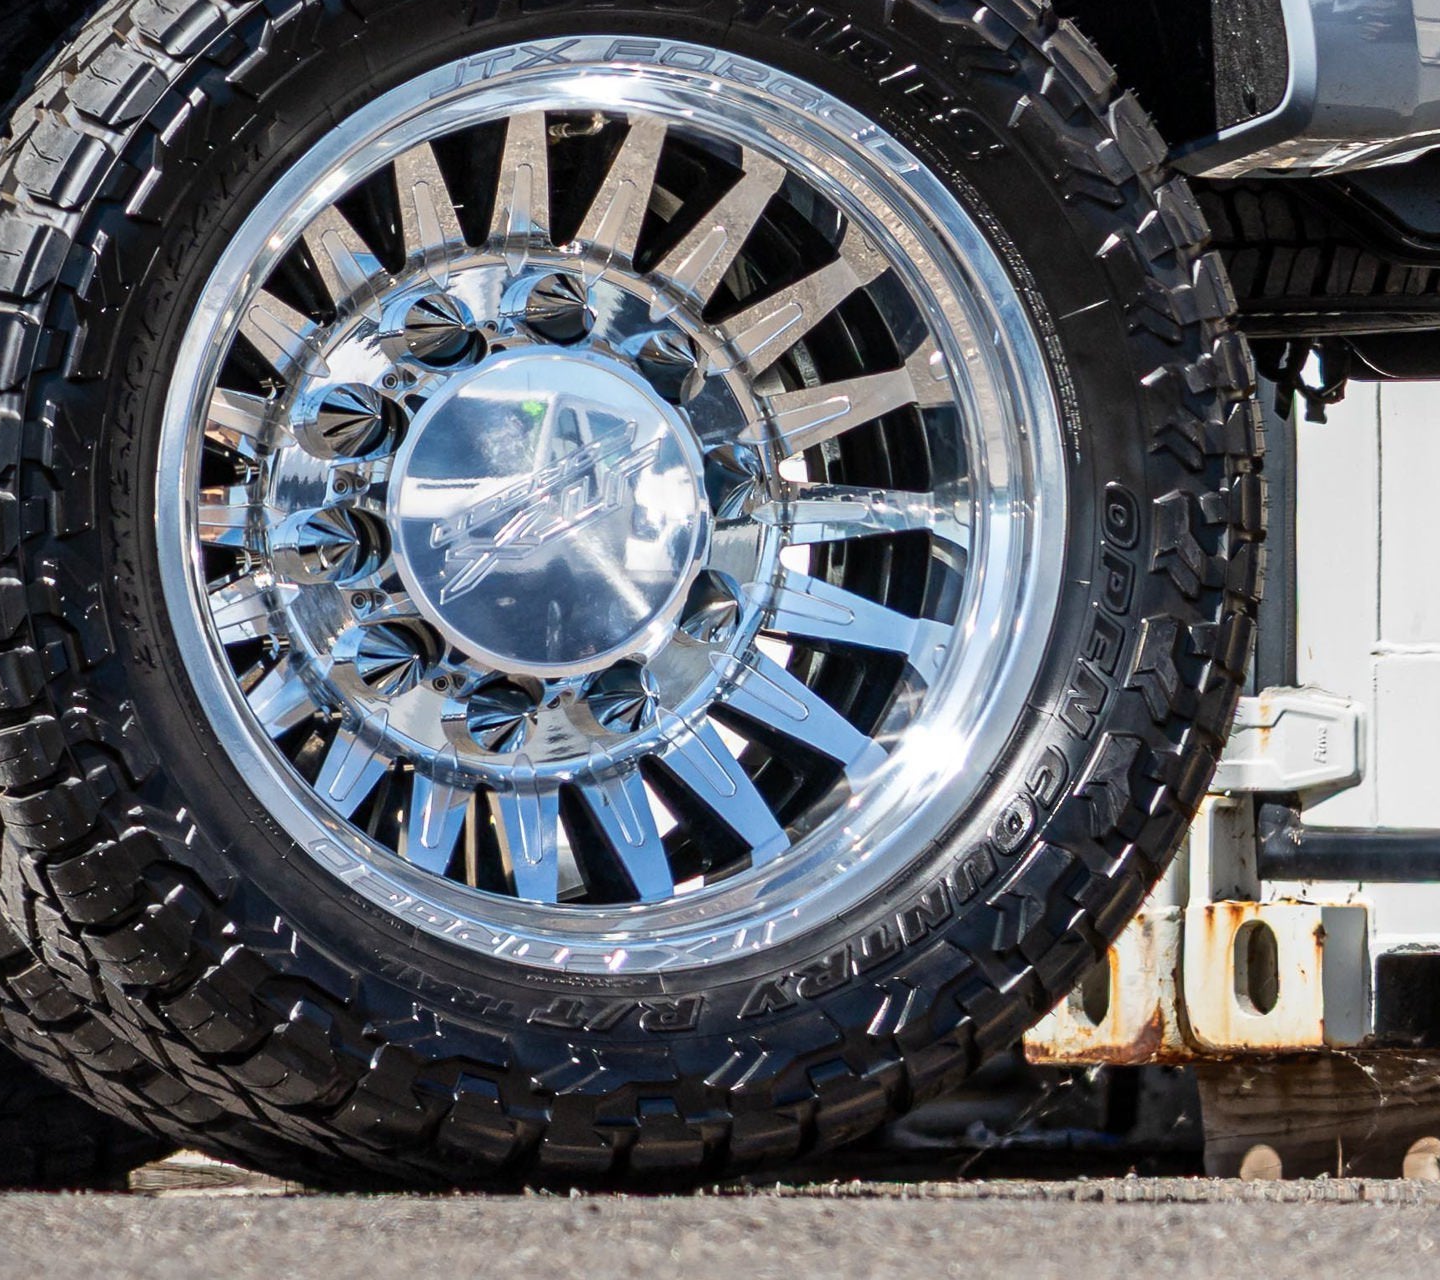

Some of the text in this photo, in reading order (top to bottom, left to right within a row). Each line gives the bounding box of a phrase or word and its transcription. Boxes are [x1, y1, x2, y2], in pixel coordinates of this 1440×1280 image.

[430, 36, 920, 174] JTX FORGED
[1060, 480, 1140, 740] OPEN
[737, 743, 1070, 1020] COUNTRY
